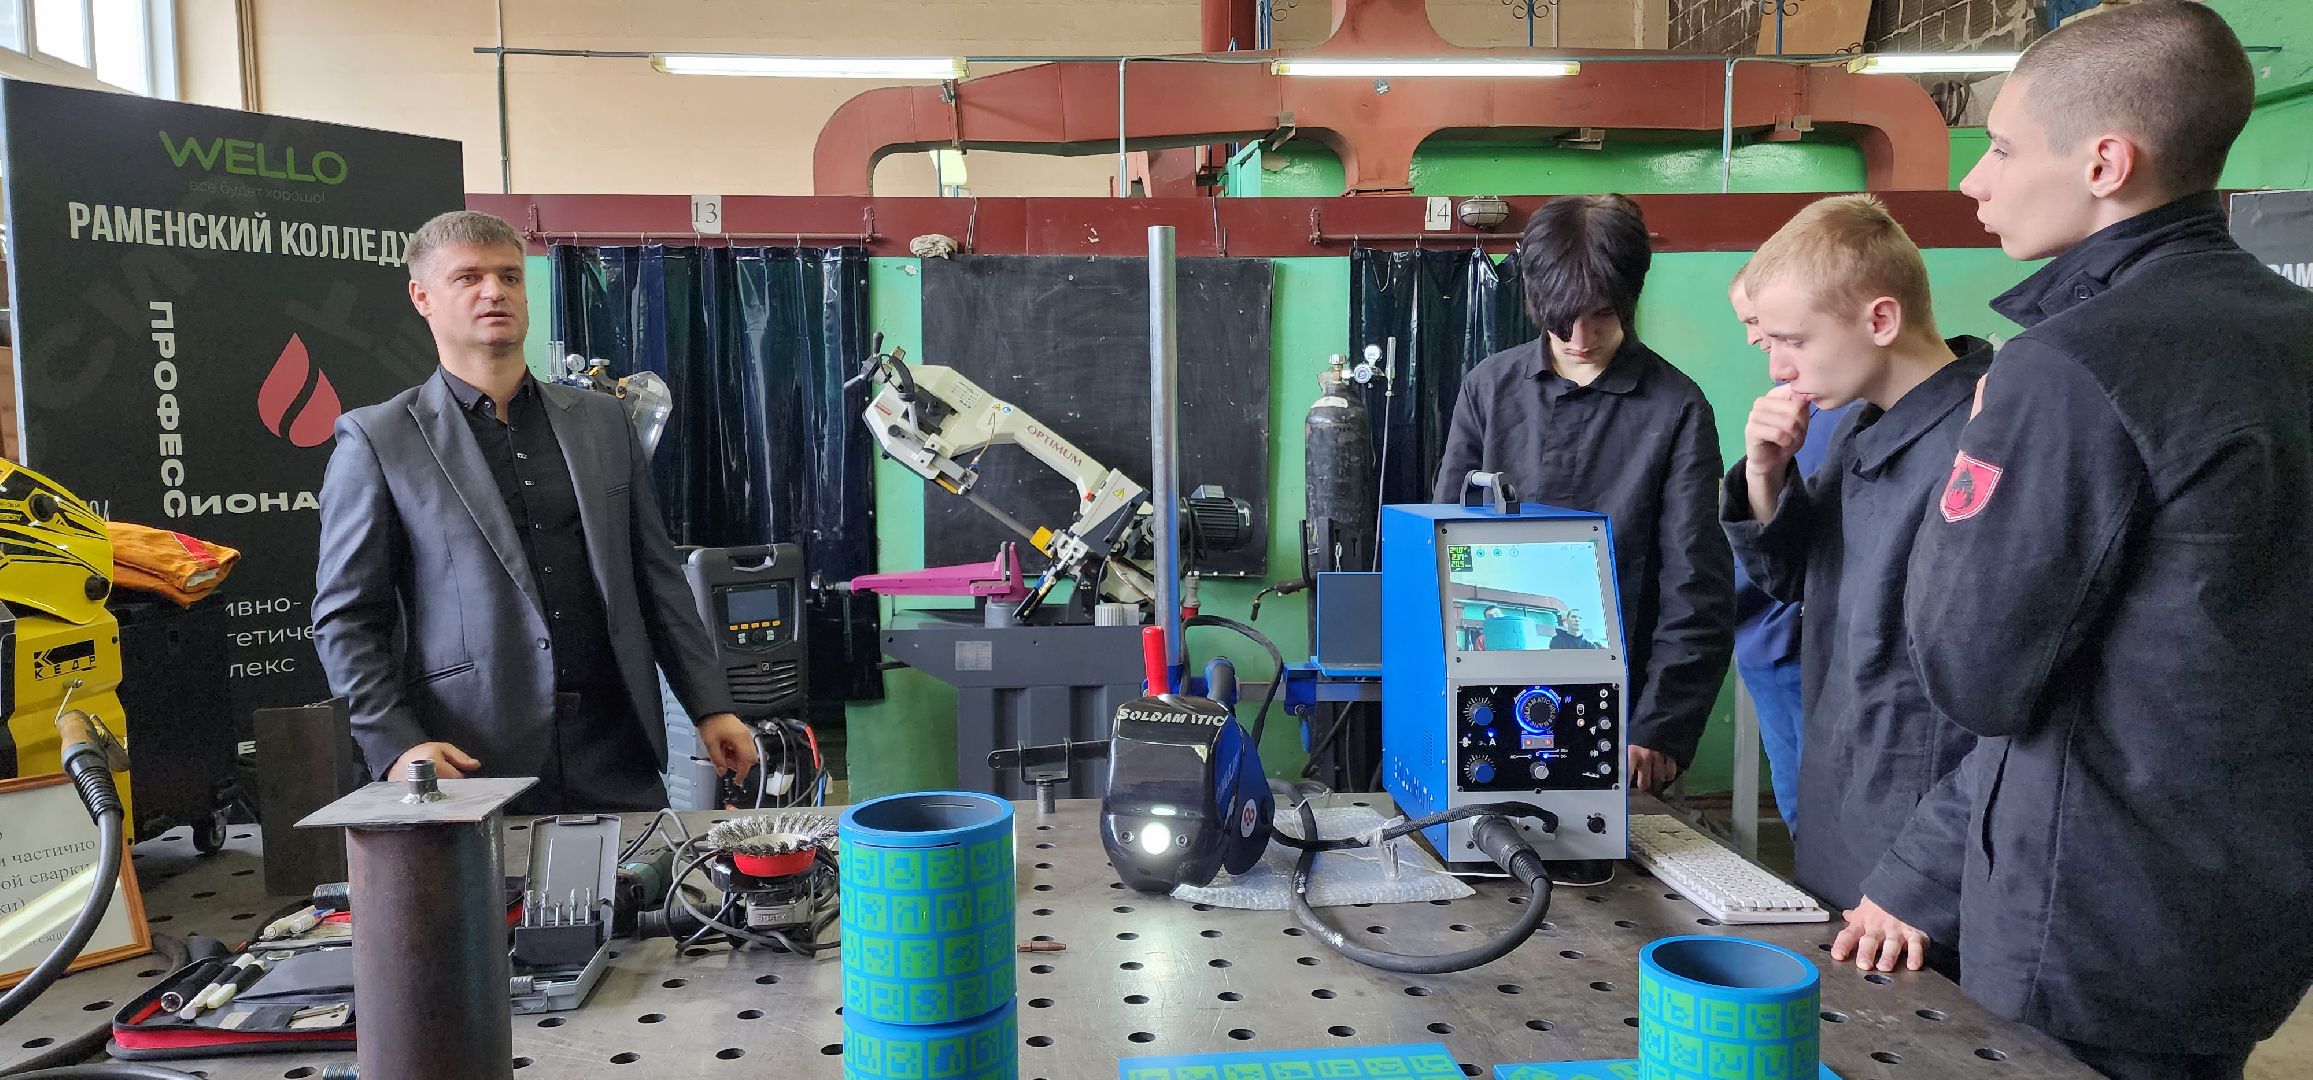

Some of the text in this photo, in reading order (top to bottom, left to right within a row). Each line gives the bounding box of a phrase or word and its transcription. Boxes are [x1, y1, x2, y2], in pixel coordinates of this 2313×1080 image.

[159, 131, 348, 185] WELLO
[693, 202, 718, 224] 13
[1427, 202, 1450, 223] 14
[68, 201, 271, 254] РАМЕНСКИЙ
[1026, 425, 1082, 467] OPTIMUM
[34, 655, 96, 680] КЕДР
[12, 840, 96, 864] частично
[30, 863, 91, 884] сварки
